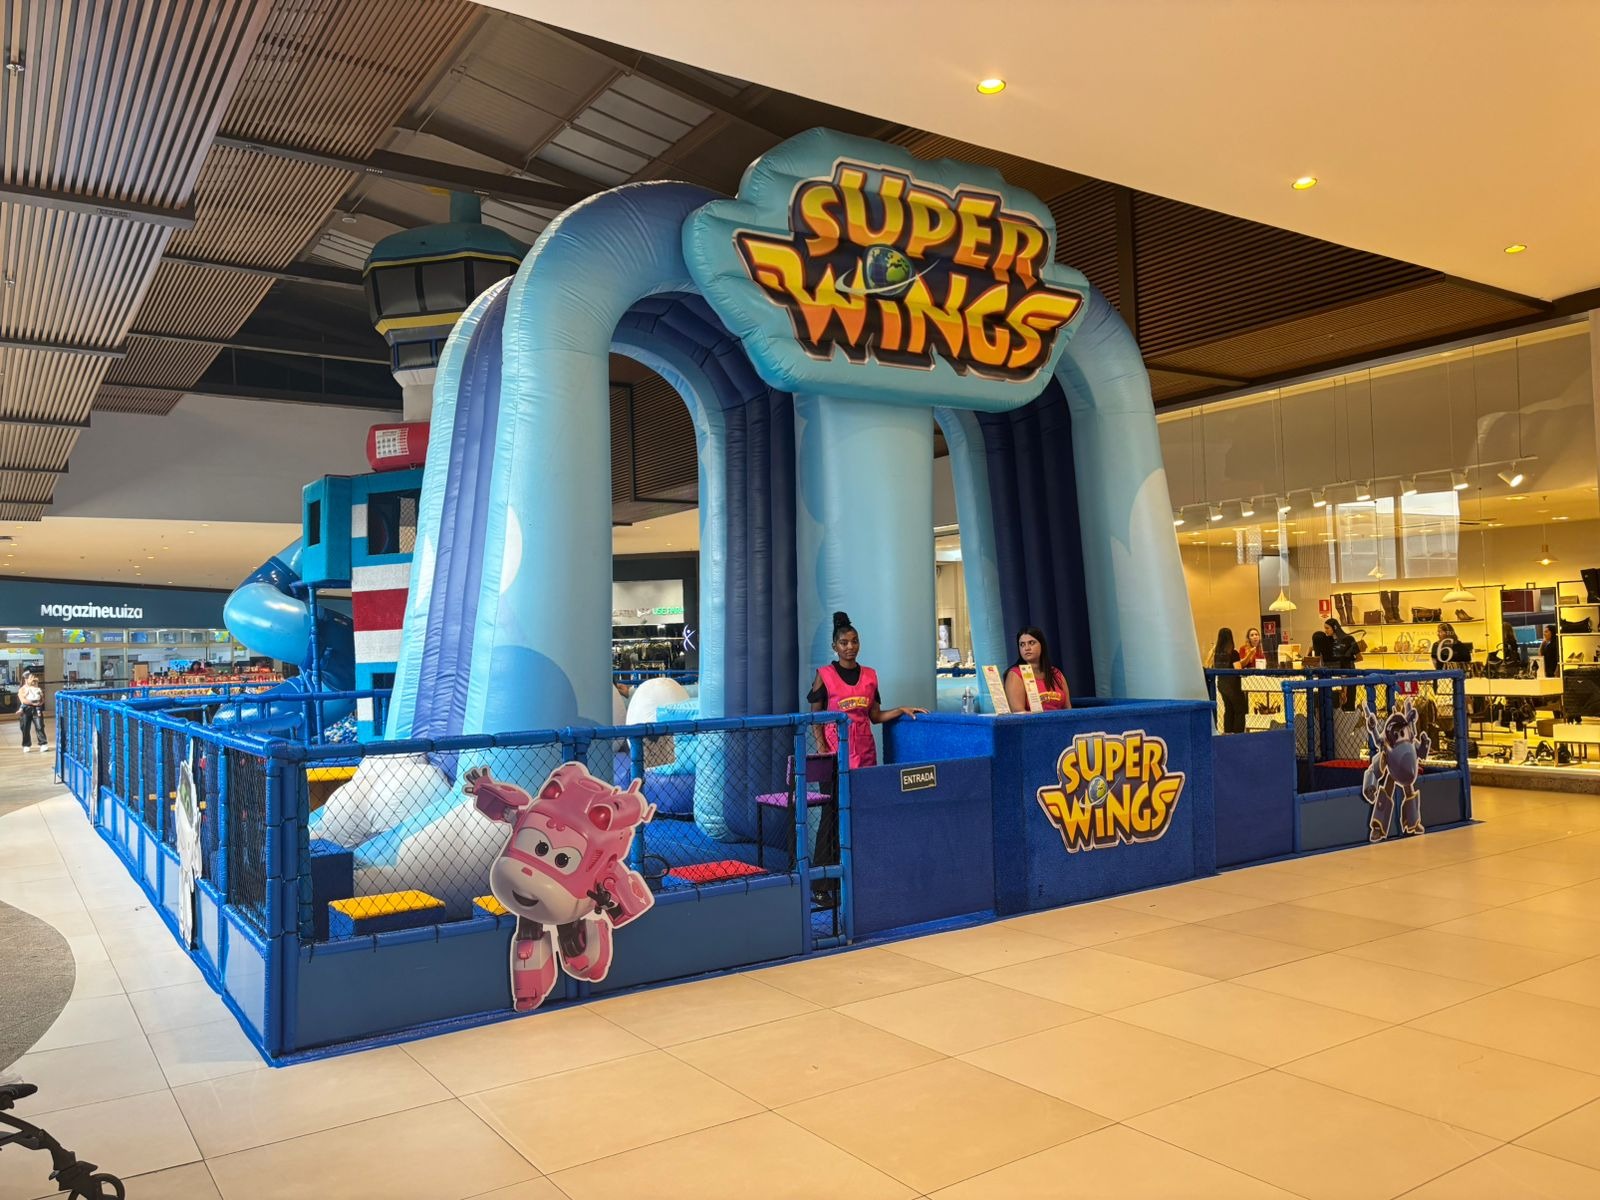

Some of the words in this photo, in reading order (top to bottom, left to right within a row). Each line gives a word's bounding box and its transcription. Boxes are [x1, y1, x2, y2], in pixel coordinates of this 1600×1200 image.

[800, 167, 1045, 289] SUPER
[903, 771, 935, 785] ENTRADA
[1062, 735, 1163, 794] SUPER
